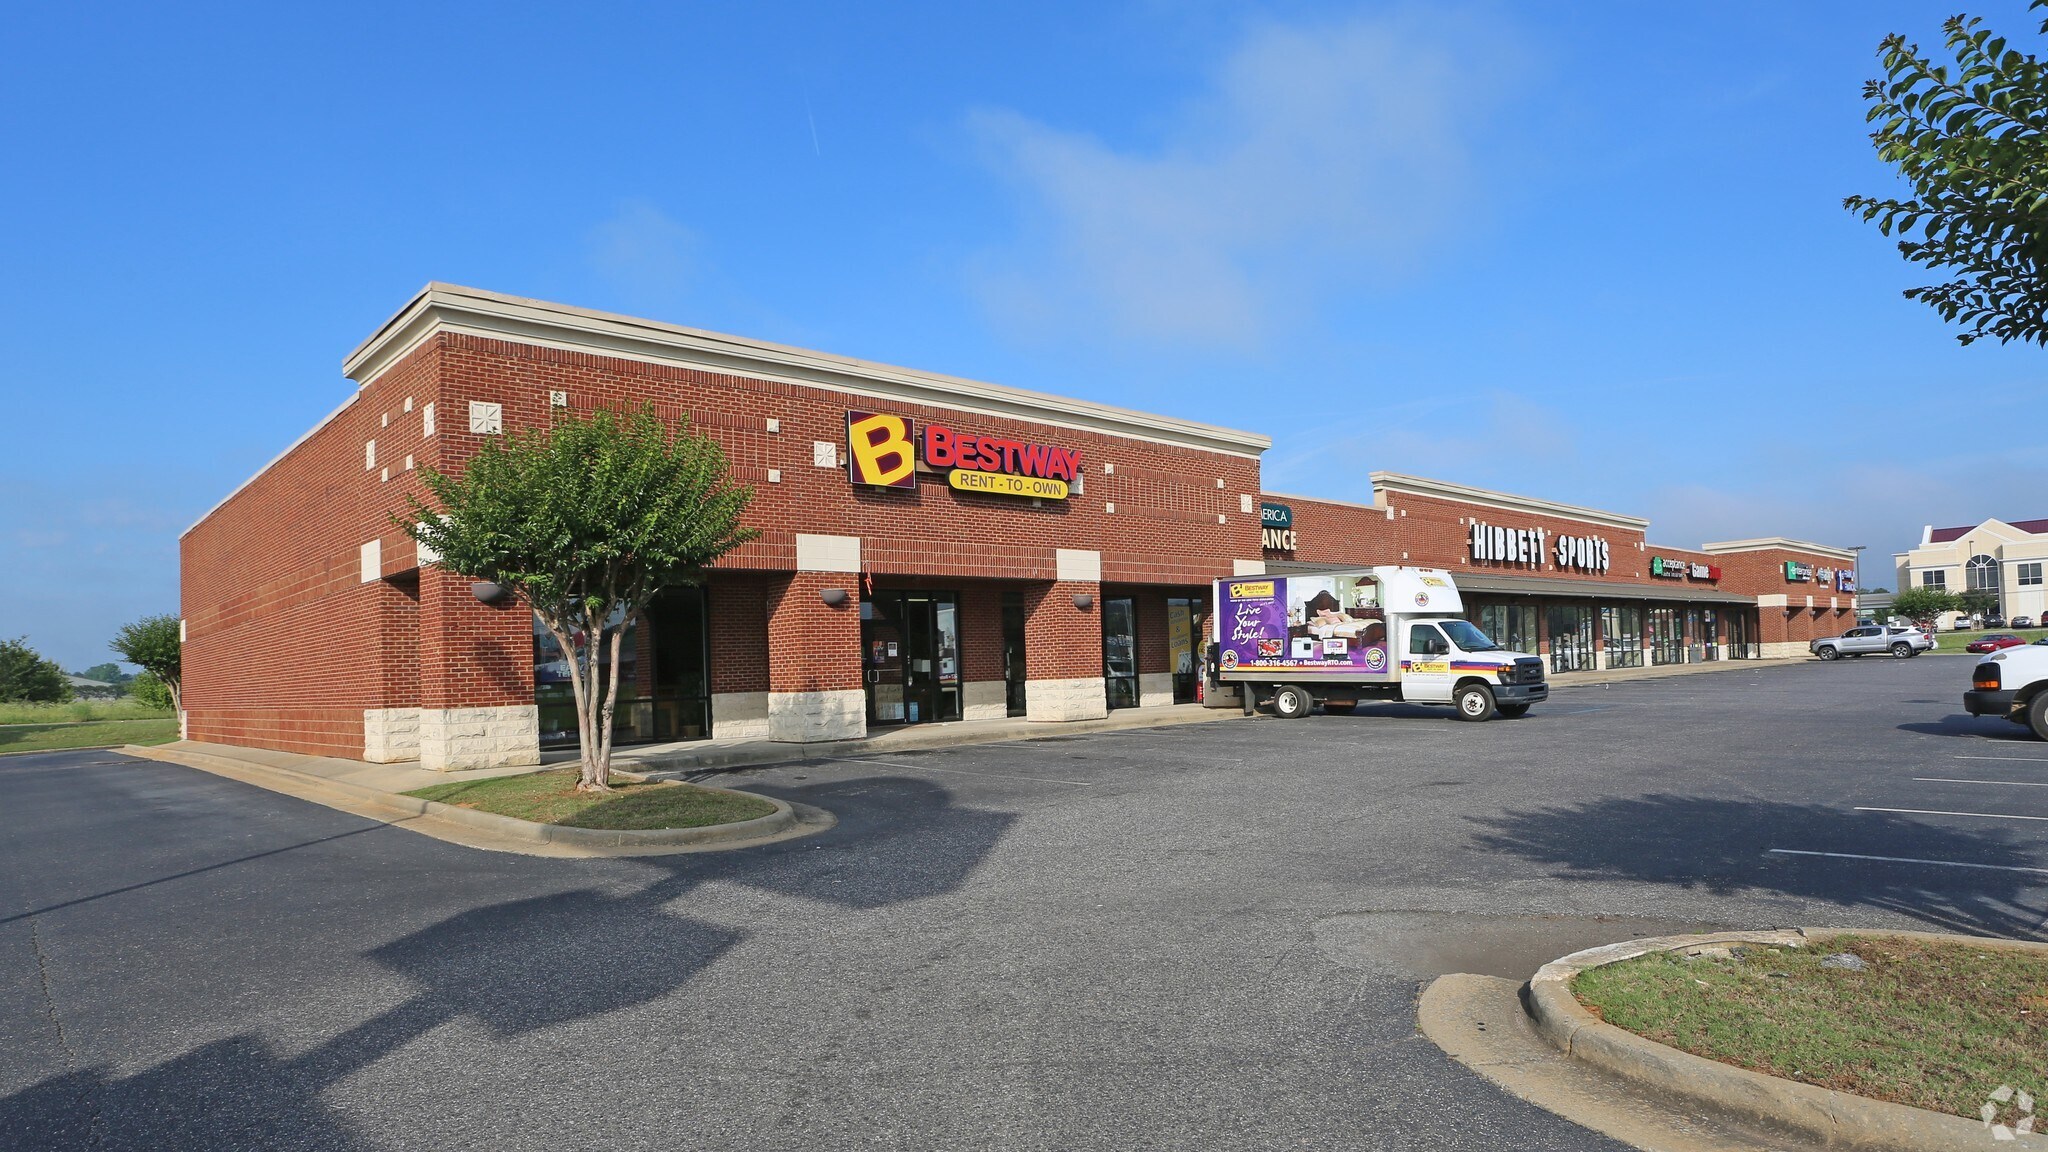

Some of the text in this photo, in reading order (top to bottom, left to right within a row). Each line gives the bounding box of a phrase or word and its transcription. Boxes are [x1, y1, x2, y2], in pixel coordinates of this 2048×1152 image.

[923, 425, 1081, 481] BESTWAY
[1261, 509, 1287, 522] ERICA
[1473, 524, 1545, 564] HIBBETT
[1559, 535, 1609, 570] SPORTS
[1237, 603, 1262, 615] Live
[1234, 615, 1262, 629] Your
[1231, 626, 1265, 645] Style!
